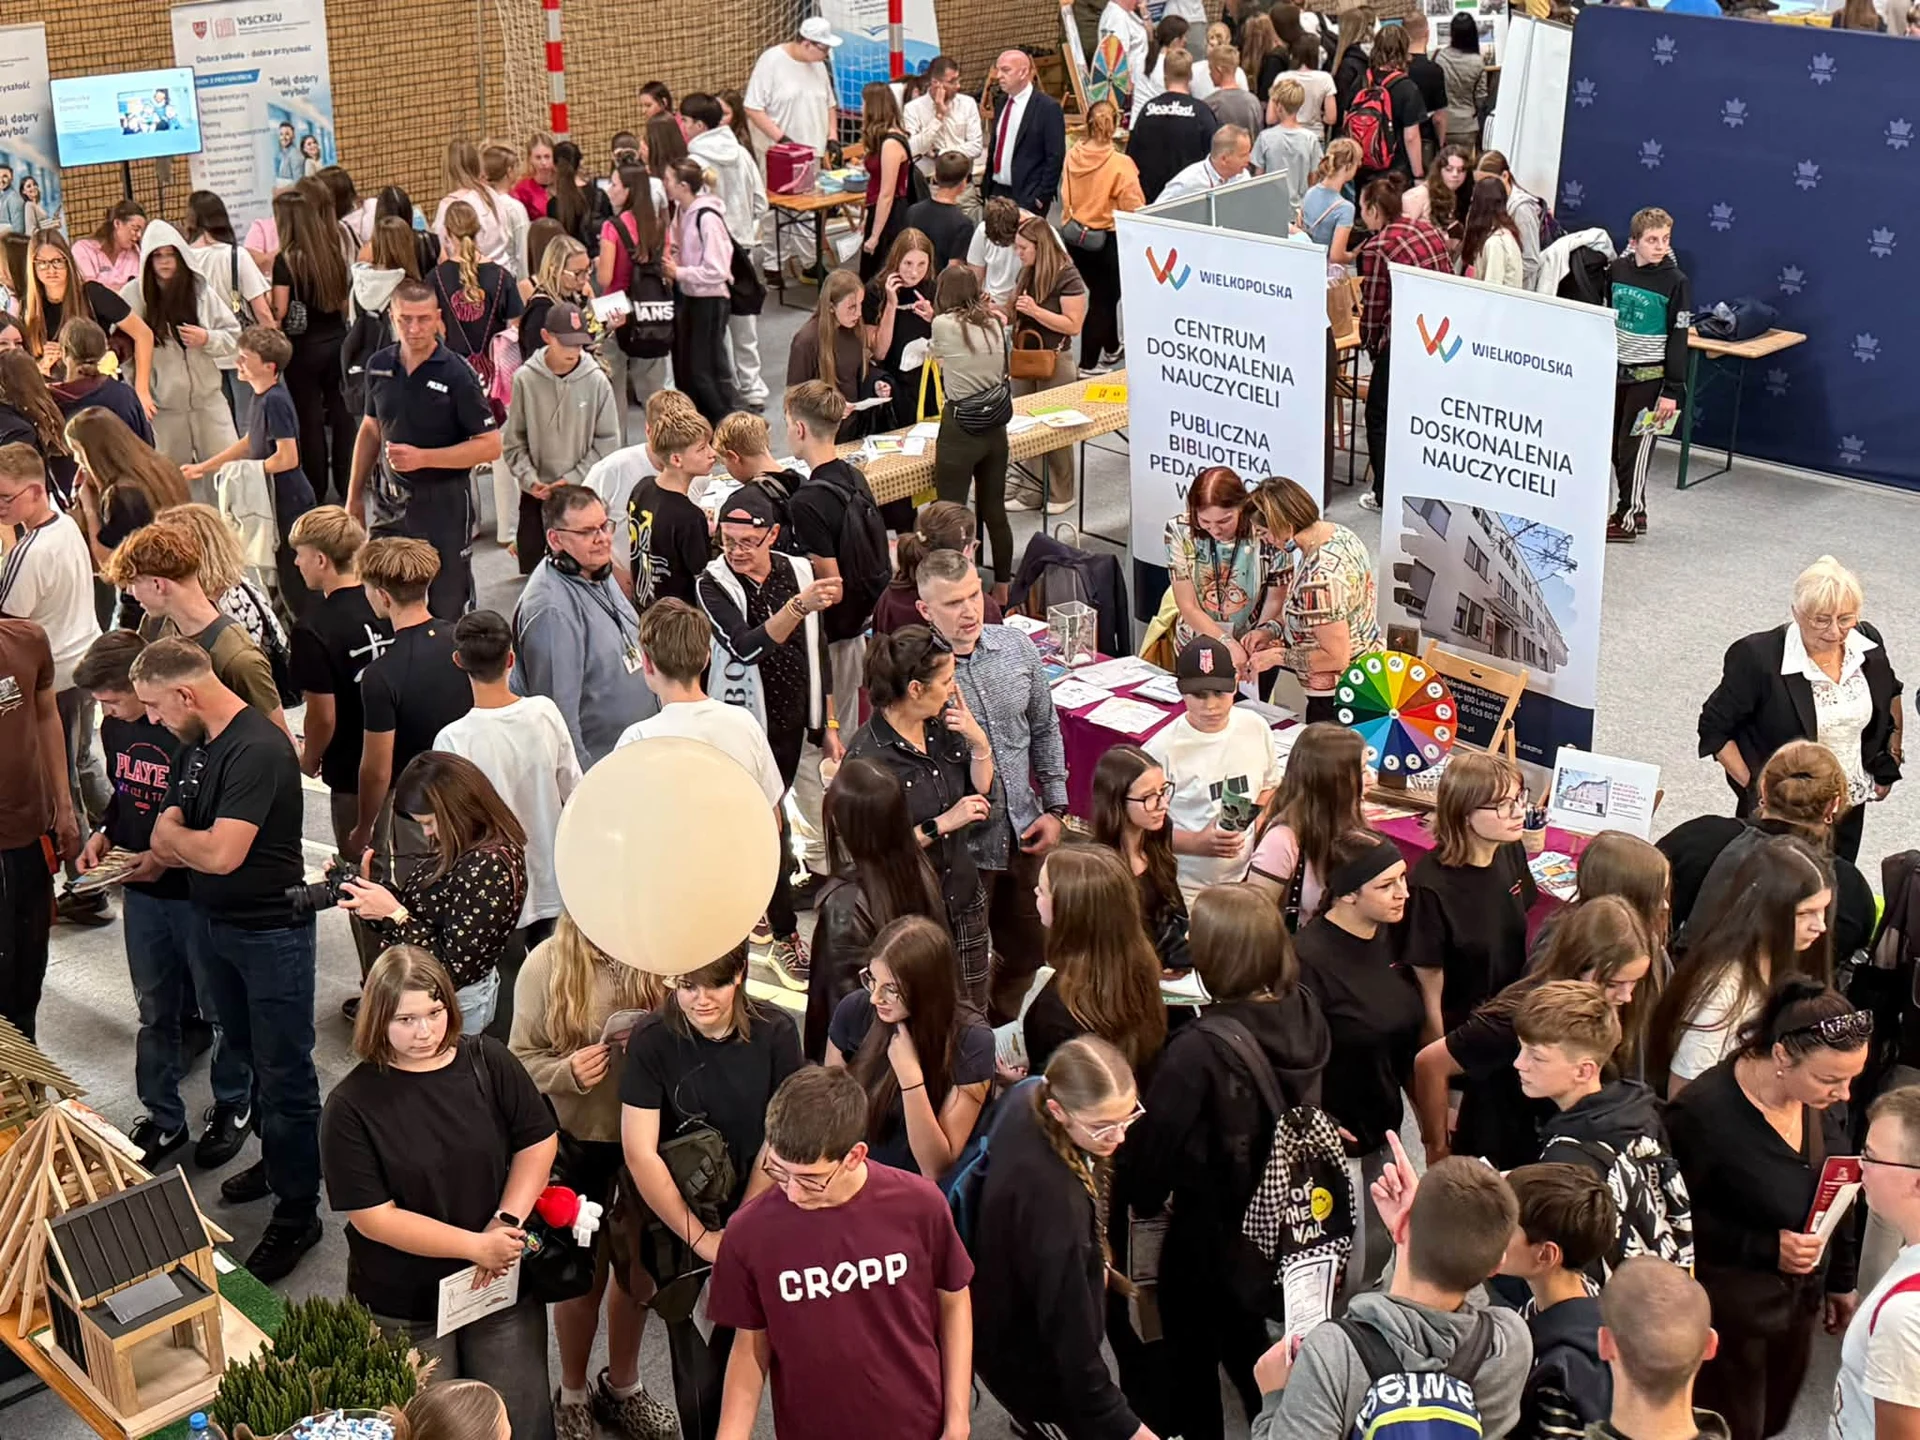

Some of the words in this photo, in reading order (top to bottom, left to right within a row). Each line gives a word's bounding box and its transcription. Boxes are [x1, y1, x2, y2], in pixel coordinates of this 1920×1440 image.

[236, 12, 283, 26] WSCKZiU
[270, 76, 291, 87] Twój
[293, 74, 319, 85] dobry
[281, 86, 311, 98] wybór
[11, 112, 38, 123] dobry
[1199, 269, 1293, 300] WIELKOPOLSKA
[633, 300, 675, 322] VANS
[1174, 317, 1266, 353] CENTRUM
[1147, 337, 1294, 386] DOSKONALENIA
[1471, 341, 1573, 378] WIELKOPOLSKA
[1161, 364, 1280, 408] NAUCZYCIELI
[1170, 410, 1270, 452] PUBLICZNA
[1440, 396, 1544, 438] CENTRUM
[1169, 434, 1273, 477] BIBLIOTEKA
[1410, 415, 1573, 475] DOSKONALENIA
[1422, 446, 1556, 498] NAUCZYCIELI
[115, 752, 170, 790] PLAYE
[779, 1252, 908, 1302] CROPP
